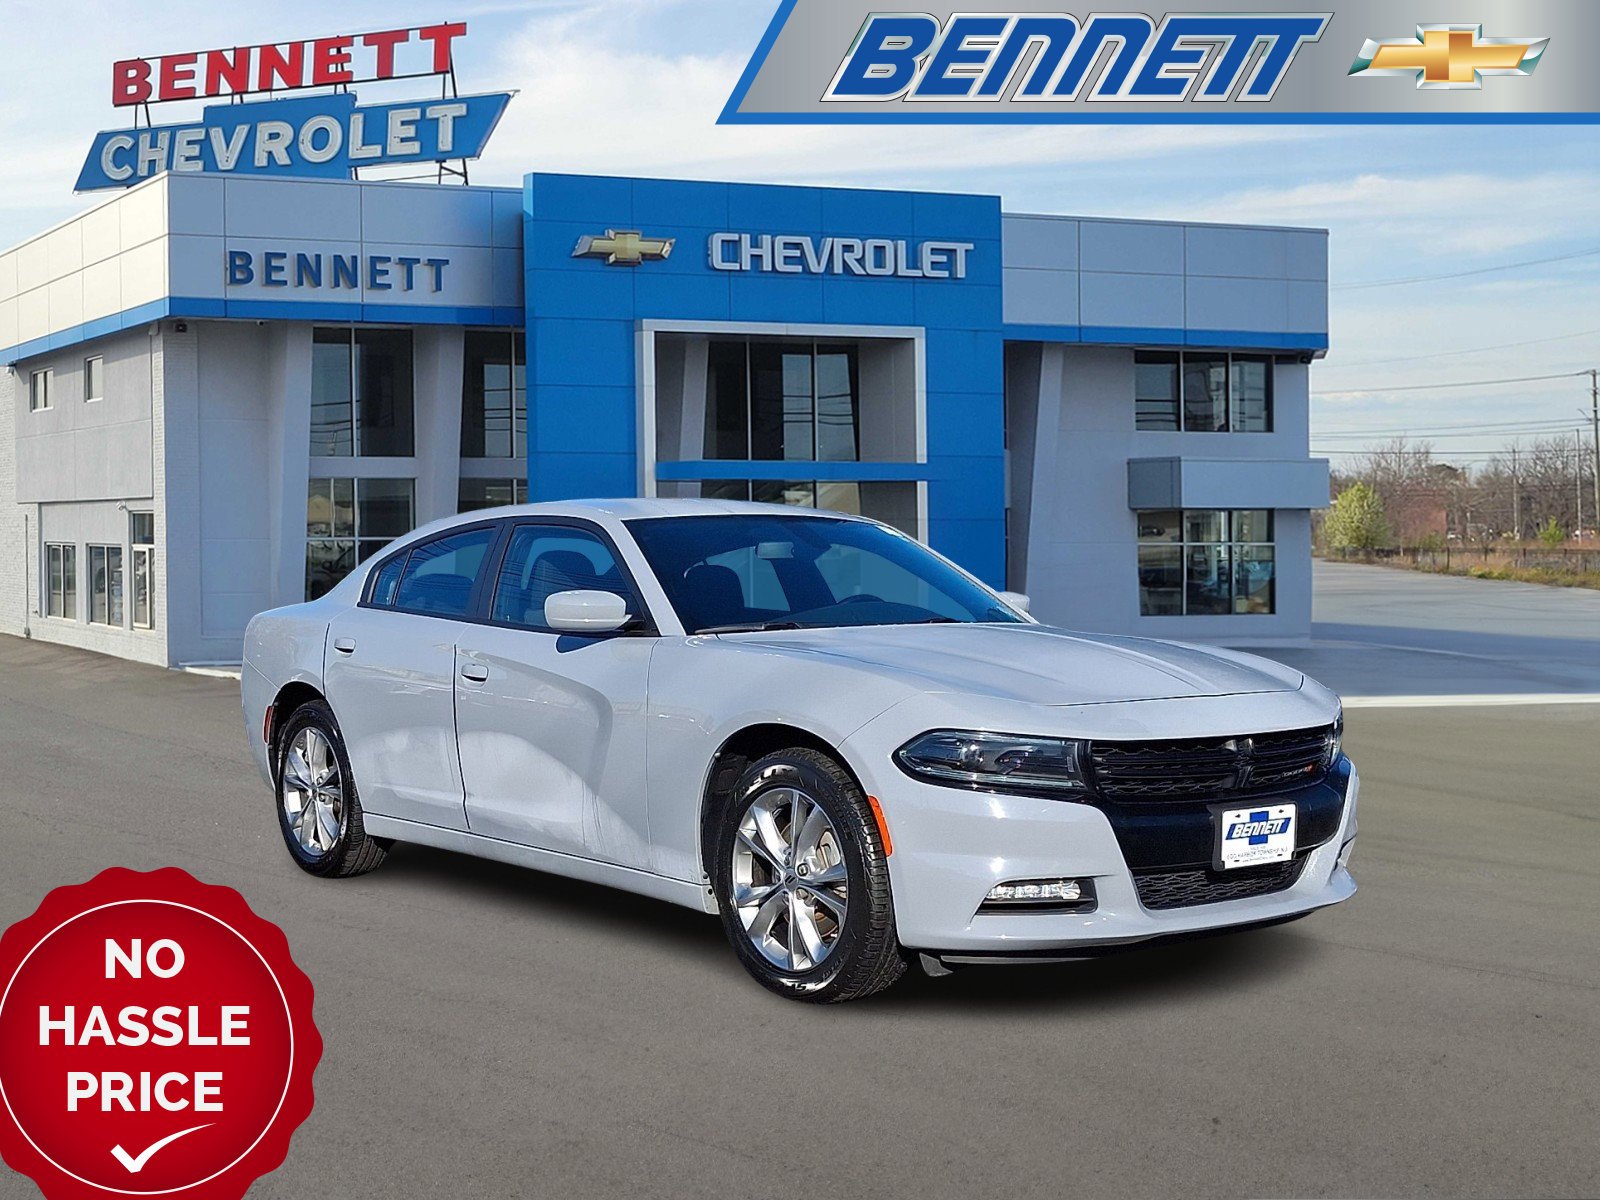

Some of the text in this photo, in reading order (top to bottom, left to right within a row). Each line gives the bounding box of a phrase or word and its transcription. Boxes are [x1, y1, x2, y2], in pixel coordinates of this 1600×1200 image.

[113, 22, 467, 106] BENNETT
[100, 103, 467, 180] CHEVROLET
[226, 250, 450, 292] BENNETT
[708, 232, 974, 278] CHEVROLET
[1231, 819, 1285, 839] BENNETT
